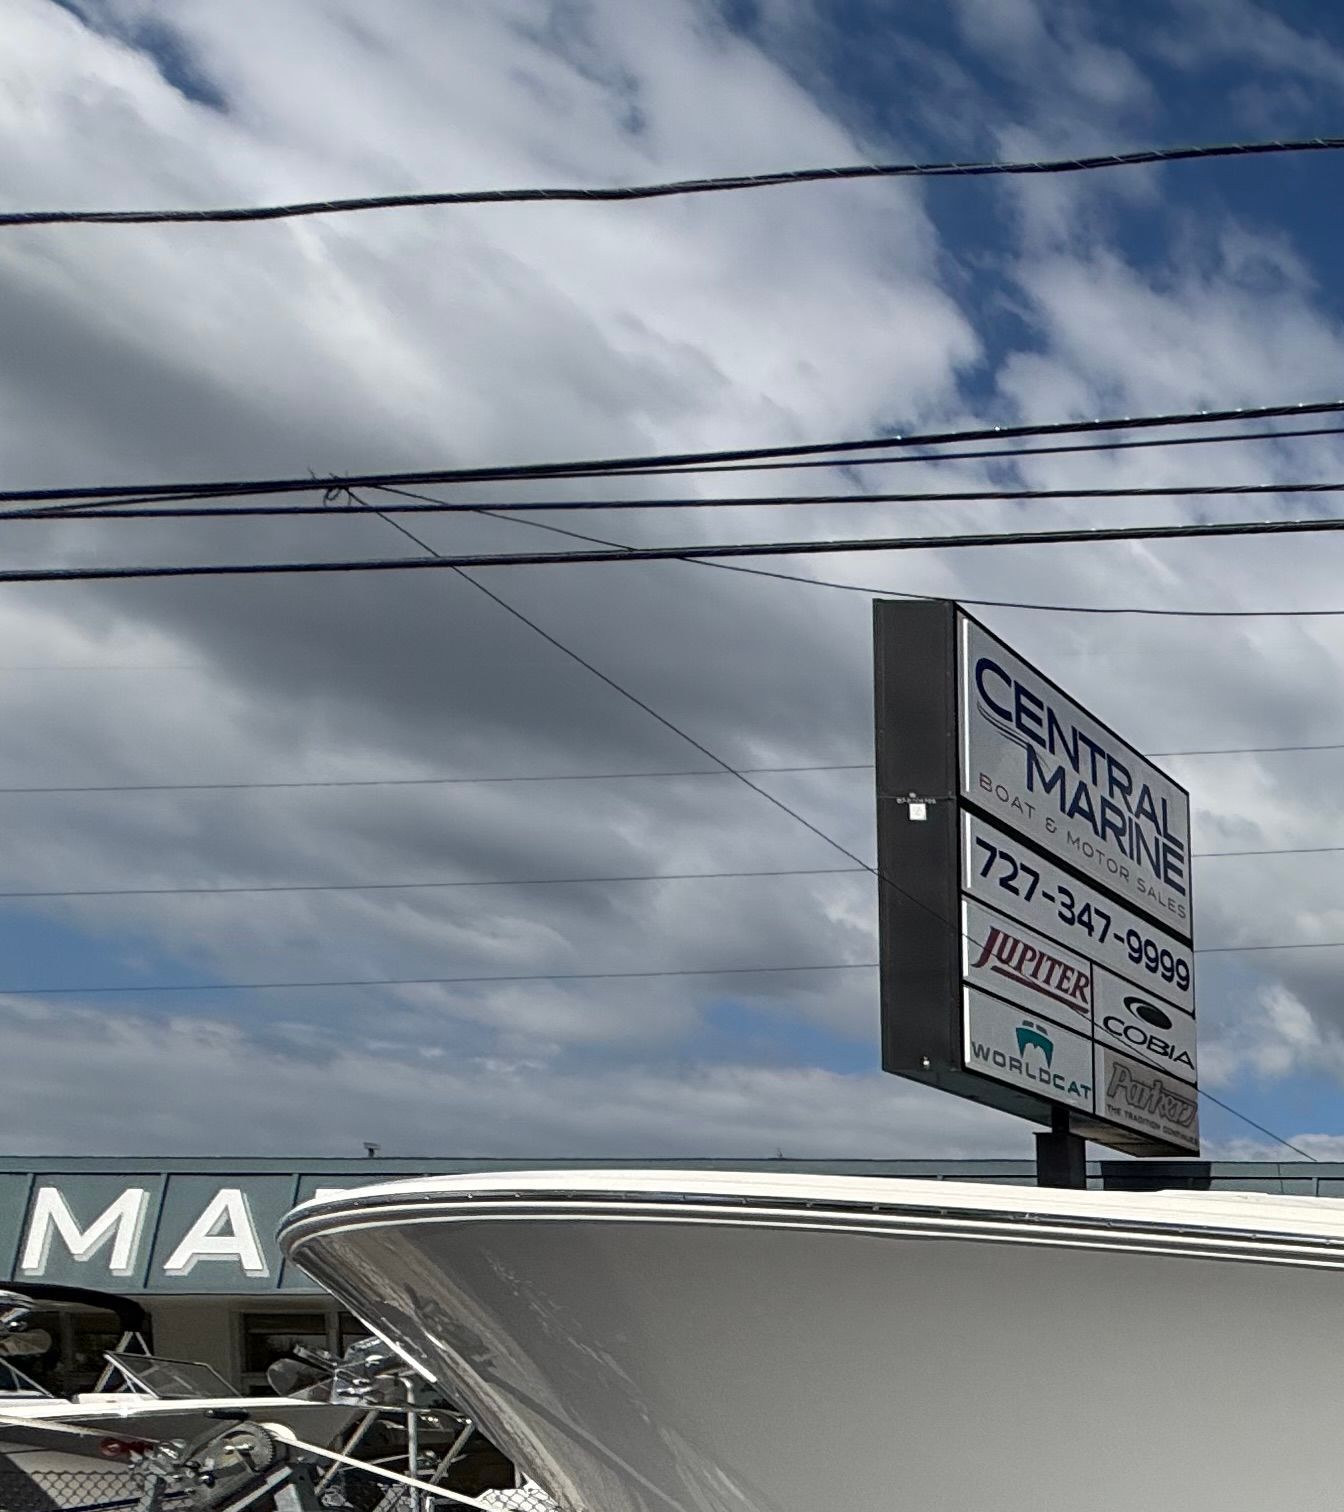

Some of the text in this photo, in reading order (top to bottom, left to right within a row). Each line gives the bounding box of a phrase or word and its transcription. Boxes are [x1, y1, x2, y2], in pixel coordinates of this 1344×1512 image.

[975, 657, 1184, 851] CENTRAL
[979, 772, 1187, 919] BOAT & MOTOR SALES
[1026, 742, 1186, 897] MARINE
[971, 925, 1090, 1006] JUPITER
[976, 836, 1190, 992] 727-347-9999
[971, 1041, 1092, 1100] WORLDCAT
[1103, 1015, 1195, 1070] COBIA
[21, 1186, 350, 1277] MA
